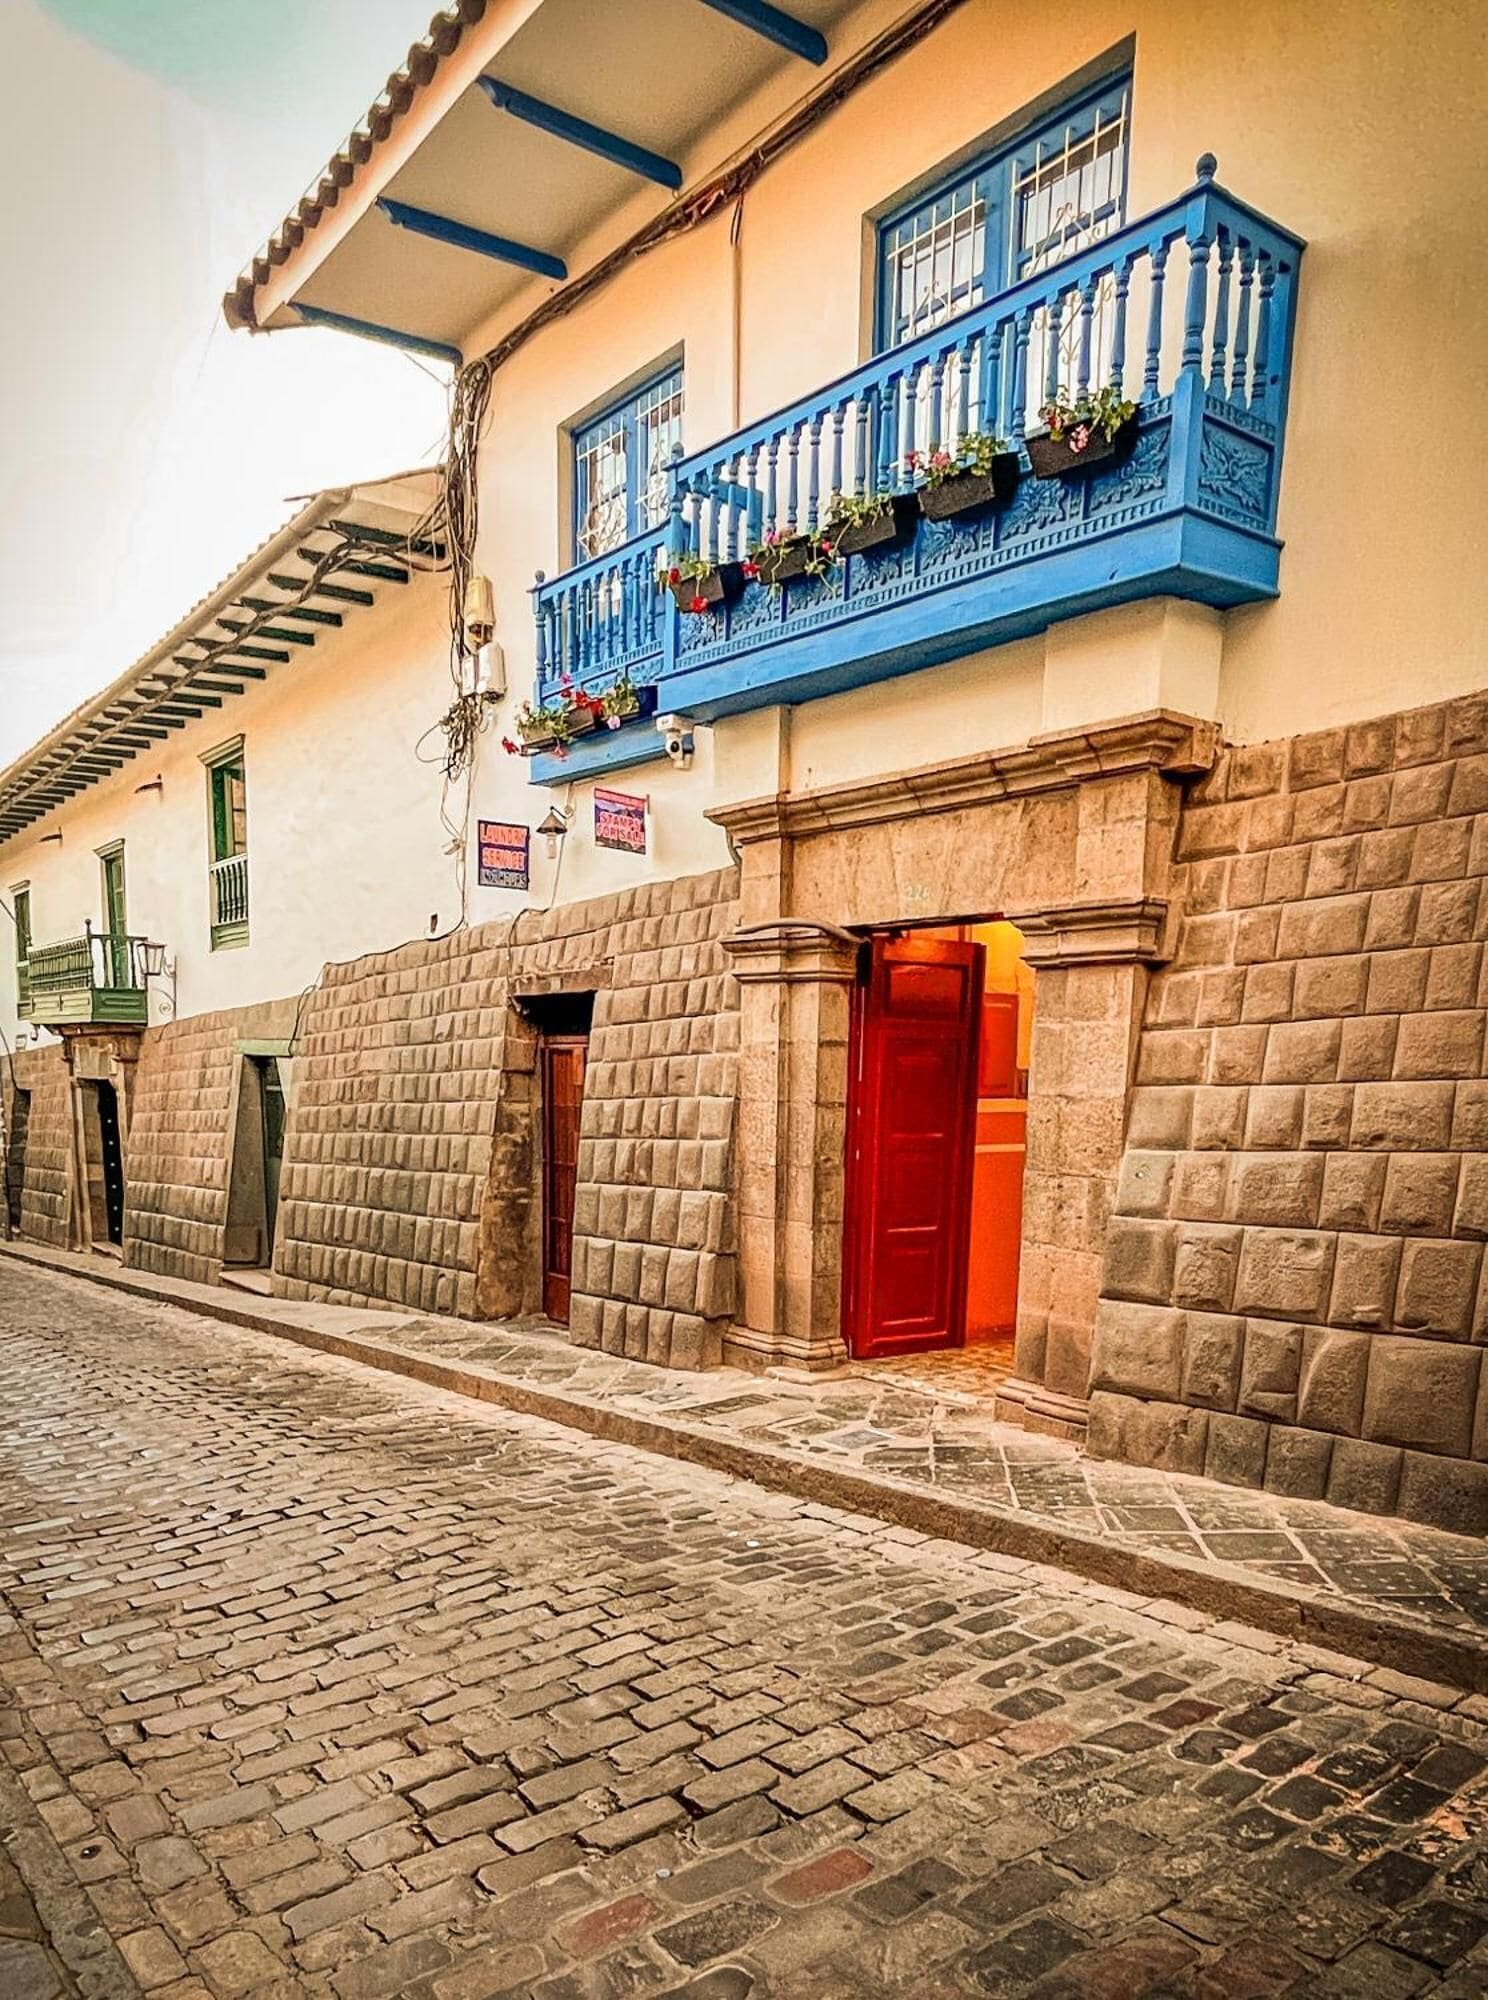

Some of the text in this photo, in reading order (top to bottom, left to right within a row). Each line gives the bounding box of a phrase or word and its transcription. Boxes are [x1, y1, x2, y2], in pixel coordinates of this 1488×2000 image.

[601, 812, 640, 827] STAMPS
[481, 824, 526, 846] LAUNDRY
[597, 823, 643, 842] FOR SALE
[483, 848, 524, 870] SERVICE
